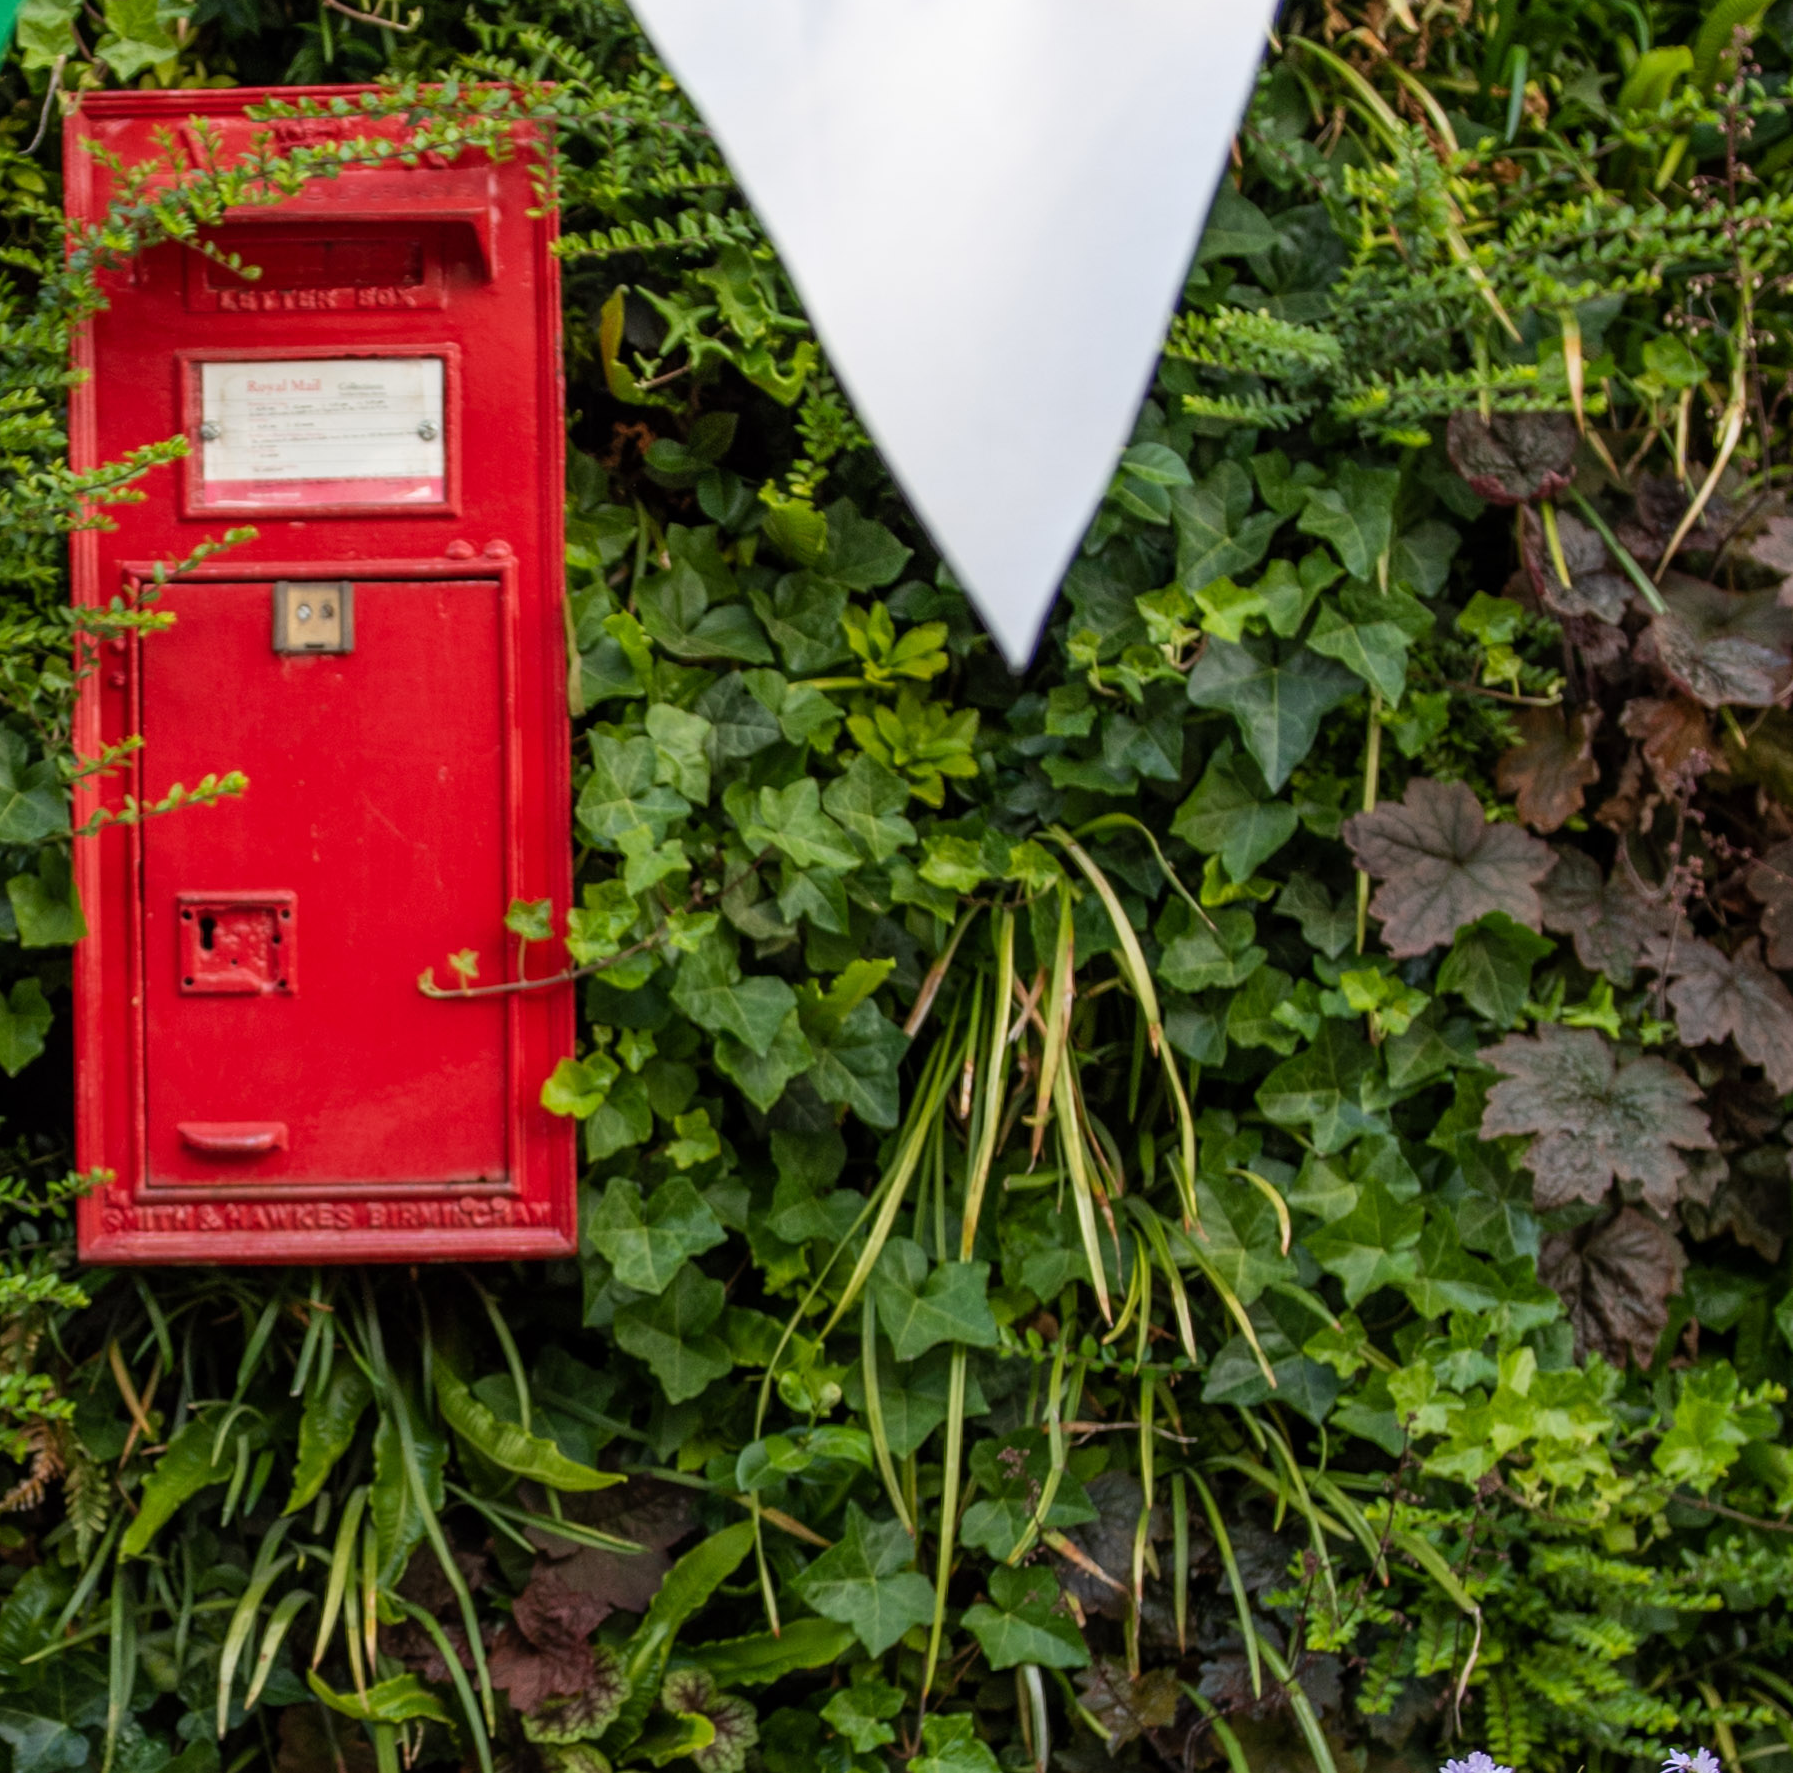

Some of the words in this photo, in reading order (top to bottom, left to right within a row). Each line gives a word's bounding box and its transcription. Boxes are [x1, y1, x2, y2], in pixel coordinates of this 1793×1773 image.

[218, 288, 338, 310] LETTER
[357, 286, 418, 308] BOX
[247, 379, 288, 394] Royal
[292, 378, 322, 392] Mail
[102, 1204, 194, 1232] SMITH
[365, 1199, 552, 1229] BIRMINGHAM
